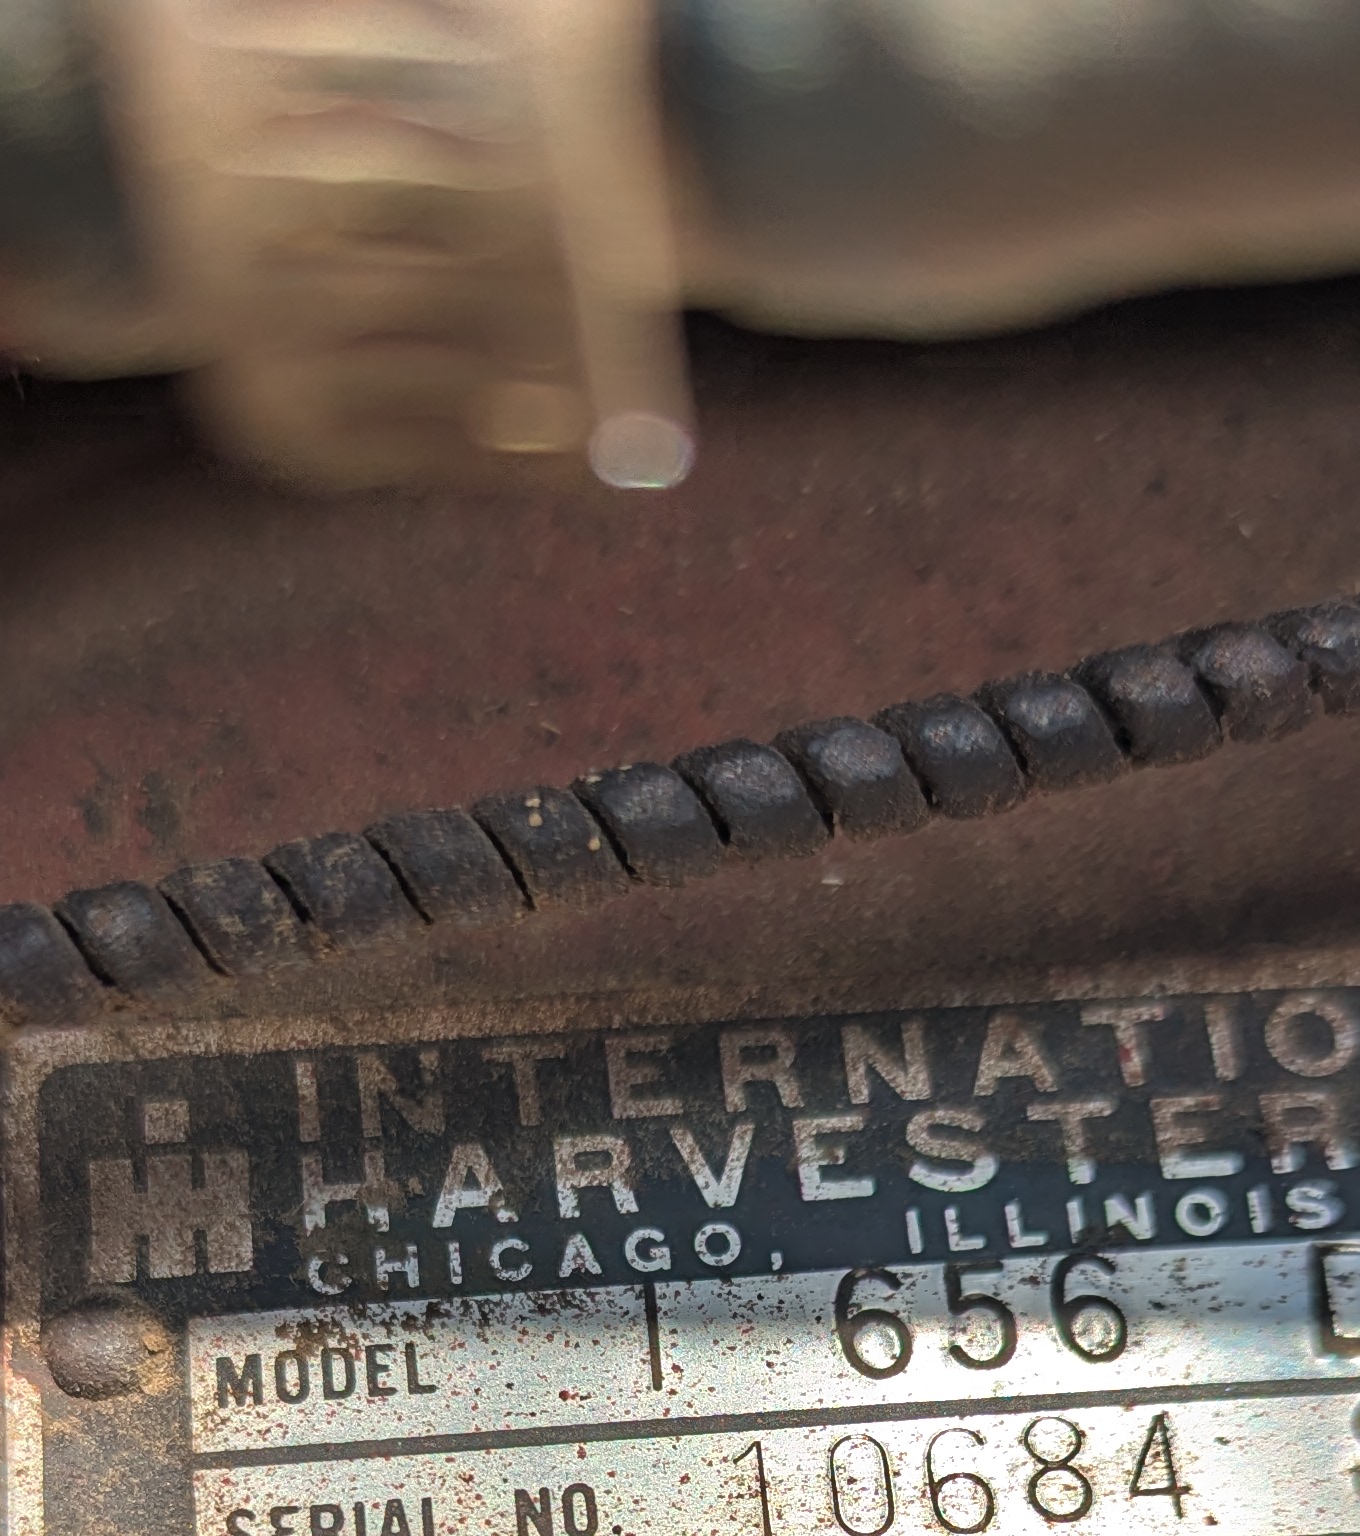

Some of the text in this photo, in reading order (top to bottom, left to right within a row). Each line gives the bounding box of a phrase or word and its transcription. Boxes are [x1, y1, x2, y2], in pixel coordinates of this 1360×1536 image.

[306, 1221, 787, 1297] CHICAGO,
[906, 1178, 1346, 1255] ILLINOIS
[215, 1341, 438, 1409] MODEL
[833, 1250, 1134, 1381] 656
